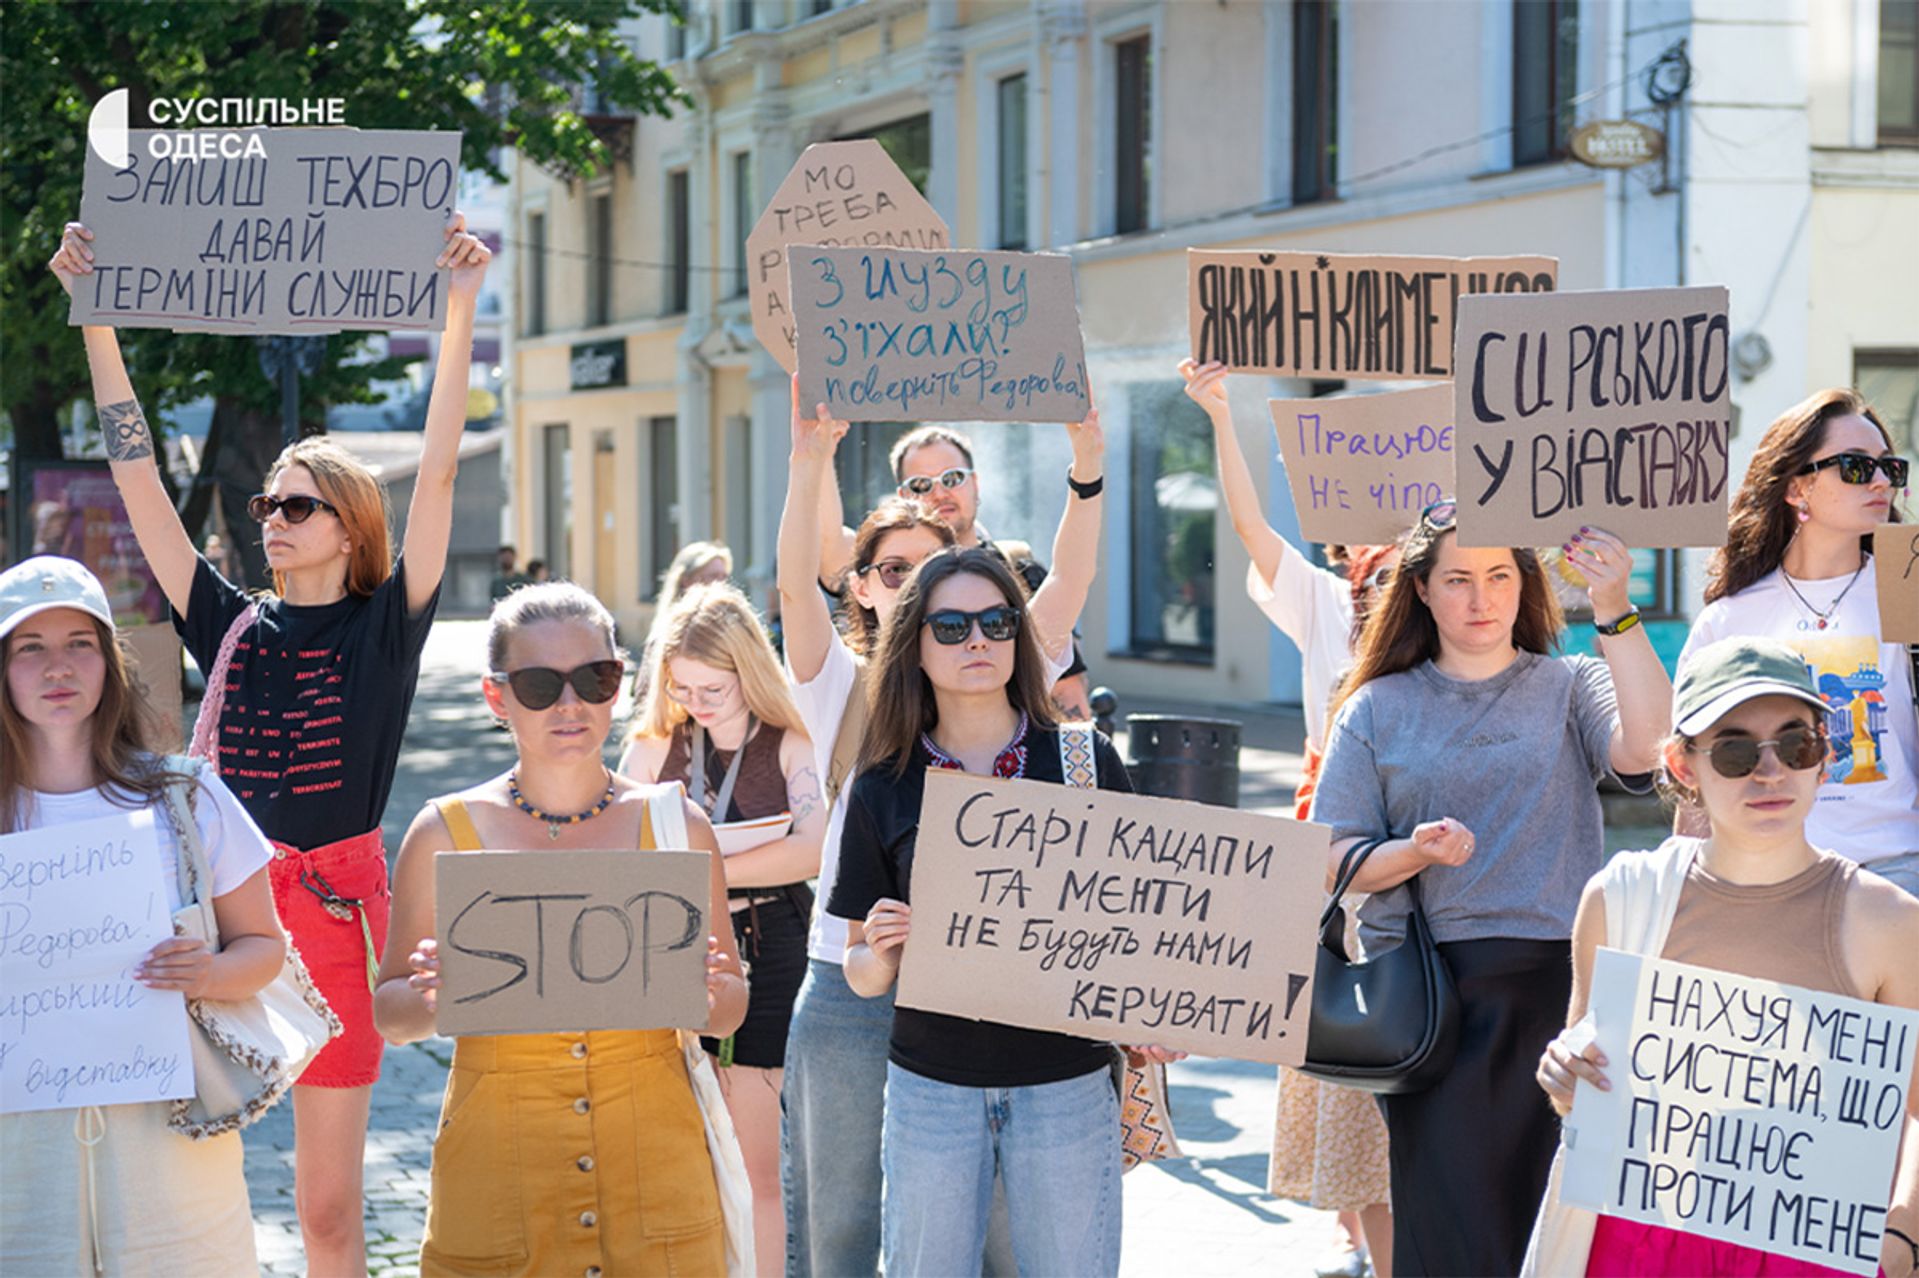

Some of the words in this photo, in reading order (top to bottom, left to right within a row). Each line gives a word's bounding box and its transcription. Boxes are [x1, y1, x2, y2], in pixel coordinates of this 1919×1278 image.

[107, 153, 268, 207] ЗАЛИШ
[296, 155, 454, 218] ТЕХБРО,
[804, 164, 856, 194] МО
[199, 211, 326, 263] ДАВАЙ
[773, 191, 898, 236] ТРЕБА
[93, 266, 267, 319] ТЕРМІНИ
[287, 270, 439, 319] СЛУЖБИ
[1199, 253, 1283, 369] ЯКИЙ
[1107, 816, 1274, 879] КАЦАПИ
[975, 868, 1032, 909] ТА
[447, 890, 703, 1005] STOP
[946, 912, 1001, 949] НЕ
[1153, 930, 1253, 970] НАМИ
[1068, 972, 1310, 1040] КЕРУВАТИ!
[1648, 970, 1792, 1050] НАХУЯ
[1802, 1003, 1908, 1073] МЕНІ
[1631, 1033, 1828, 1123] СИСТЕМА,
[1838, 1076, 1903, 1131] ЩО
[1628, 1097, 1814, 1180] ПРАЦЮЄ
[1618, 1158, 1755, 1231] ПРОТИ
[1769, 1189, 1887, 1262] МЕНЕ
